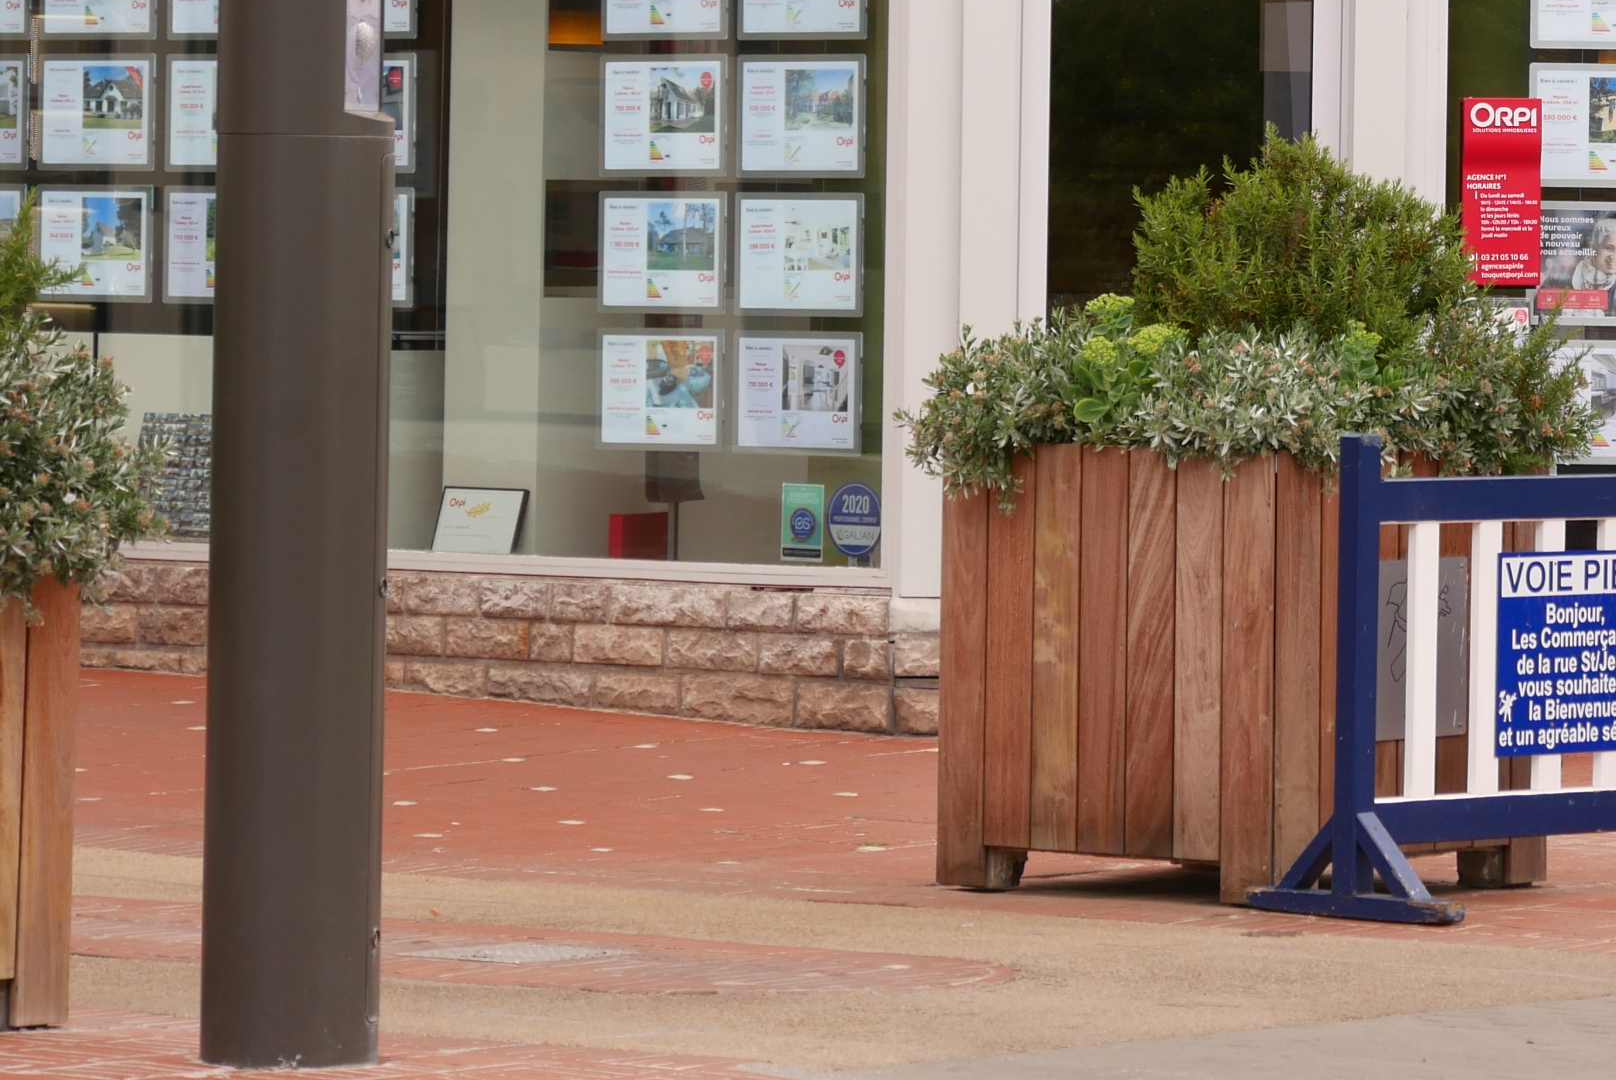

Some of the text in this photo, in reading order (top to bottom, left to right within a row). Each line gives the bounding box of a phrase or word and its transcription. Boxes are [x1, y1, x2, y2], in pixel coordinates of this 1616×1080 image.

[1470, 102, 1537, 128] ORPI
[1550, 232, 1582, 240] pouvoir
[841, 494, 870, 514] 2020
[842, 530, 875, 541] GALIAN
[1506, 560, 1574, 593] VOIE
[1546, 603, 1605, 628] Bonjour,
[1512, 629, 1537, 650] Les
[1517, 654, 1534, 675] de
[1538, 653, 1549, 674] la
[1554, 657, 1578, 673] rue
[1518, 681, 1552, 697] vous
[1528, 700, 1541, 721] la
[1499, 728, 1512, 747] et
[1516, 730, 1535, 746] un
[1538, 721, 1599, 749] agréable
